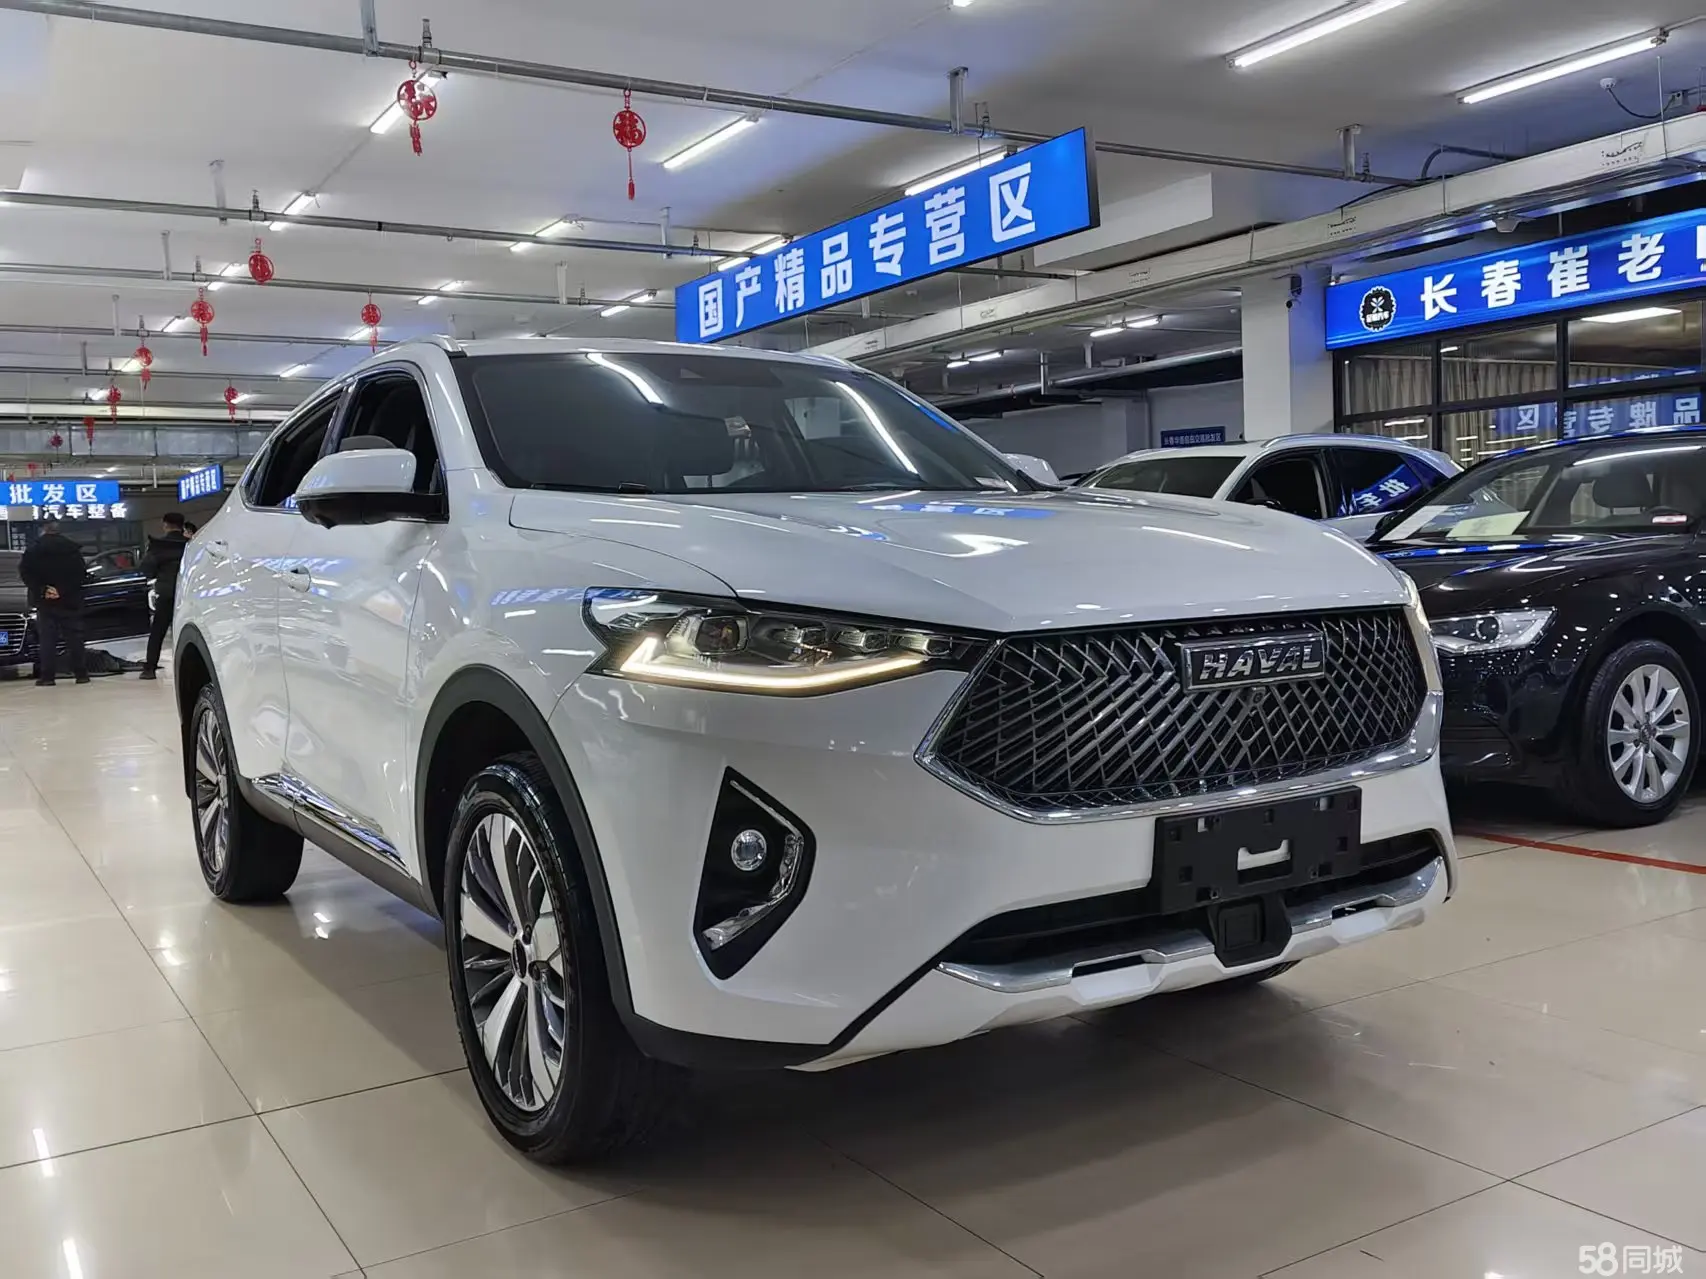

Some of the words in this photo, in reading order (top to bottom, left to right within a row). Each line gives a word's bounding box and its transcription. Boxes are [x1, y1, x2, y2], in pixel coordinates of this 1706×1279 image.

[698, 162, 1036, 337] 国产精品专营区
[9, 483, 98, 504] 批发区
[1200, 645, 1321, 680] HAVAL
